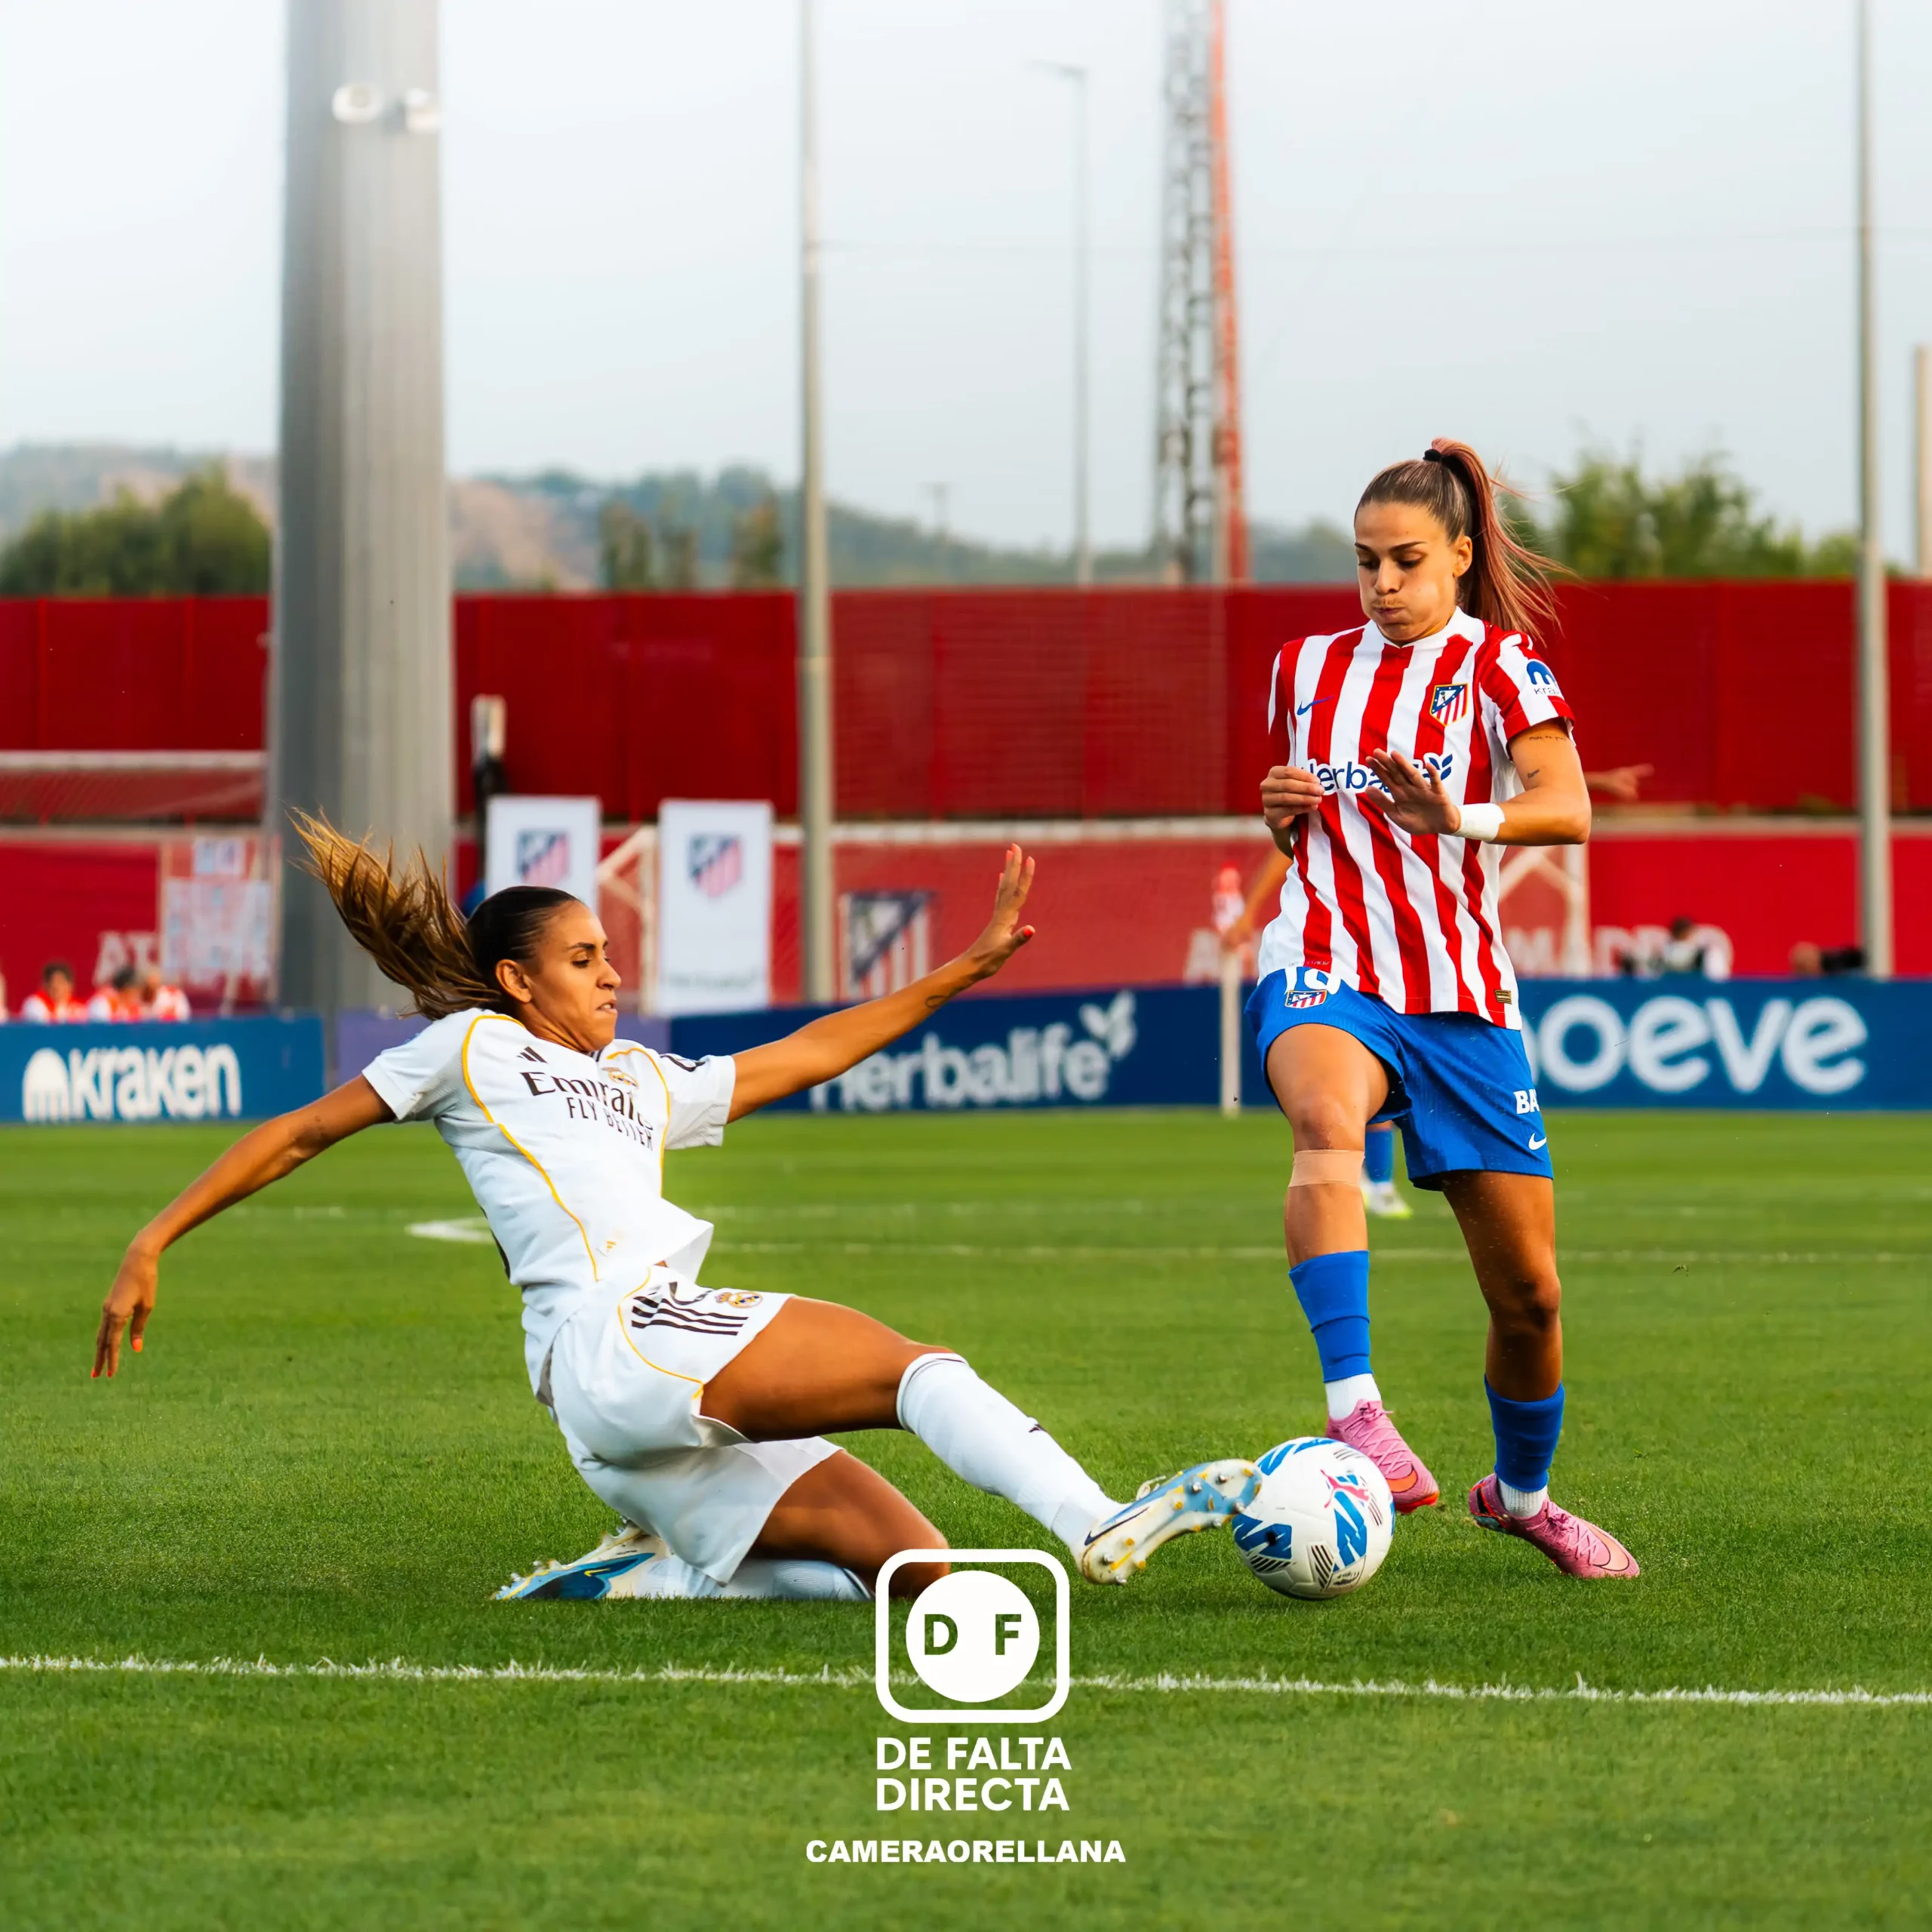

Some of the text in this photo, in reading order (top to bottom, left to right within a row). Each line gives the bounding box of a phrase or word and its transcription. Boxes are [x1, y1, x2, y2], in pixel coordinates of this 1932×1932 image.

[69, 1043, 242, 1120] kraken
[1520, 995, 1869, 1094] oeve
[566, 1097, 598, 1121] FLY
